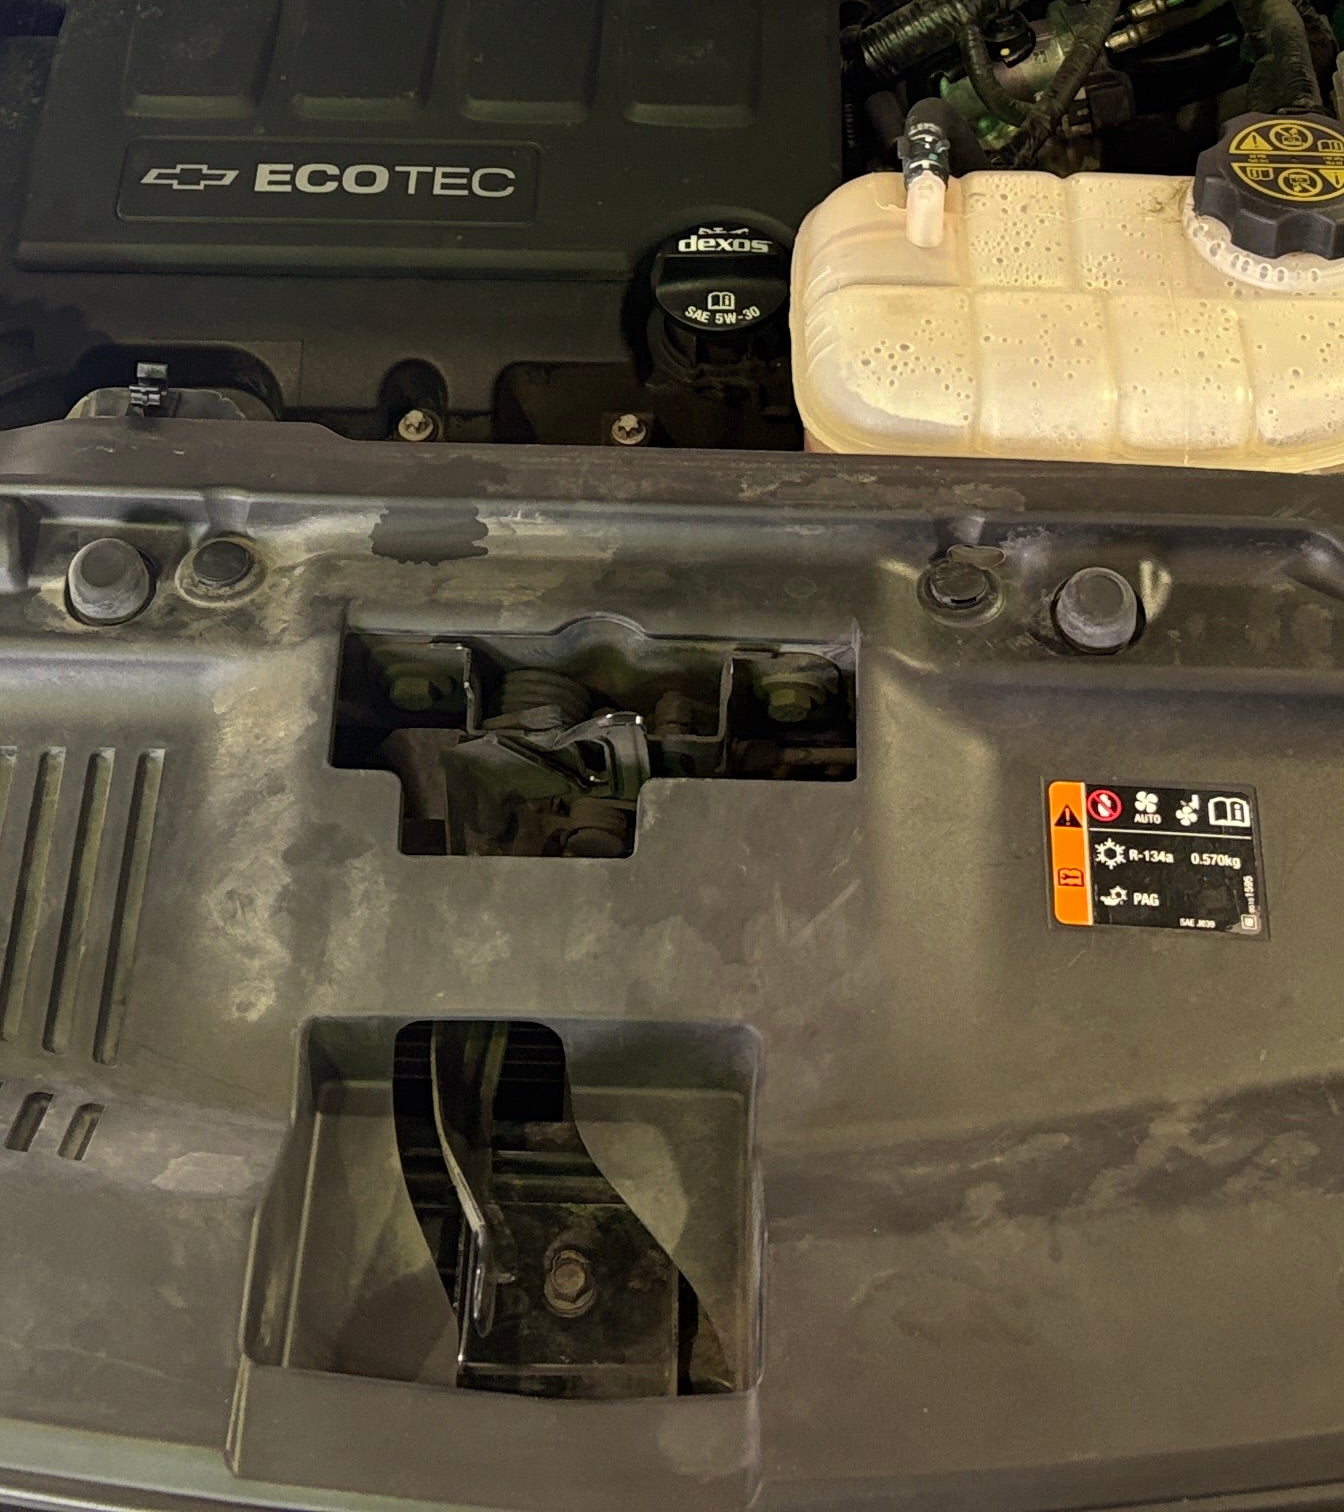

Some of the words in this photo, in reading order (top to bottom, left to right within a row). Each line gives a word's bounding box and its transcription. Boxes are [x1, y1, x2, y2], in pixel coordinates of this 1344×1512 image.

[254, 163, 516, 198] ECOTEC
[678, 234, 773, 253] dexos
[685, 305, 711, 324] SAE
[714, 305, 761, 325] 5W-30
[1133, 813, 1162, 825] AUTO
[1128, 848, 1175, 864] R-134a
[1190, 852, 1242, 870] 0.570kg
[1132, 892, 1160, 907] PAG
[1179, 917, 1195, 928] SAE
